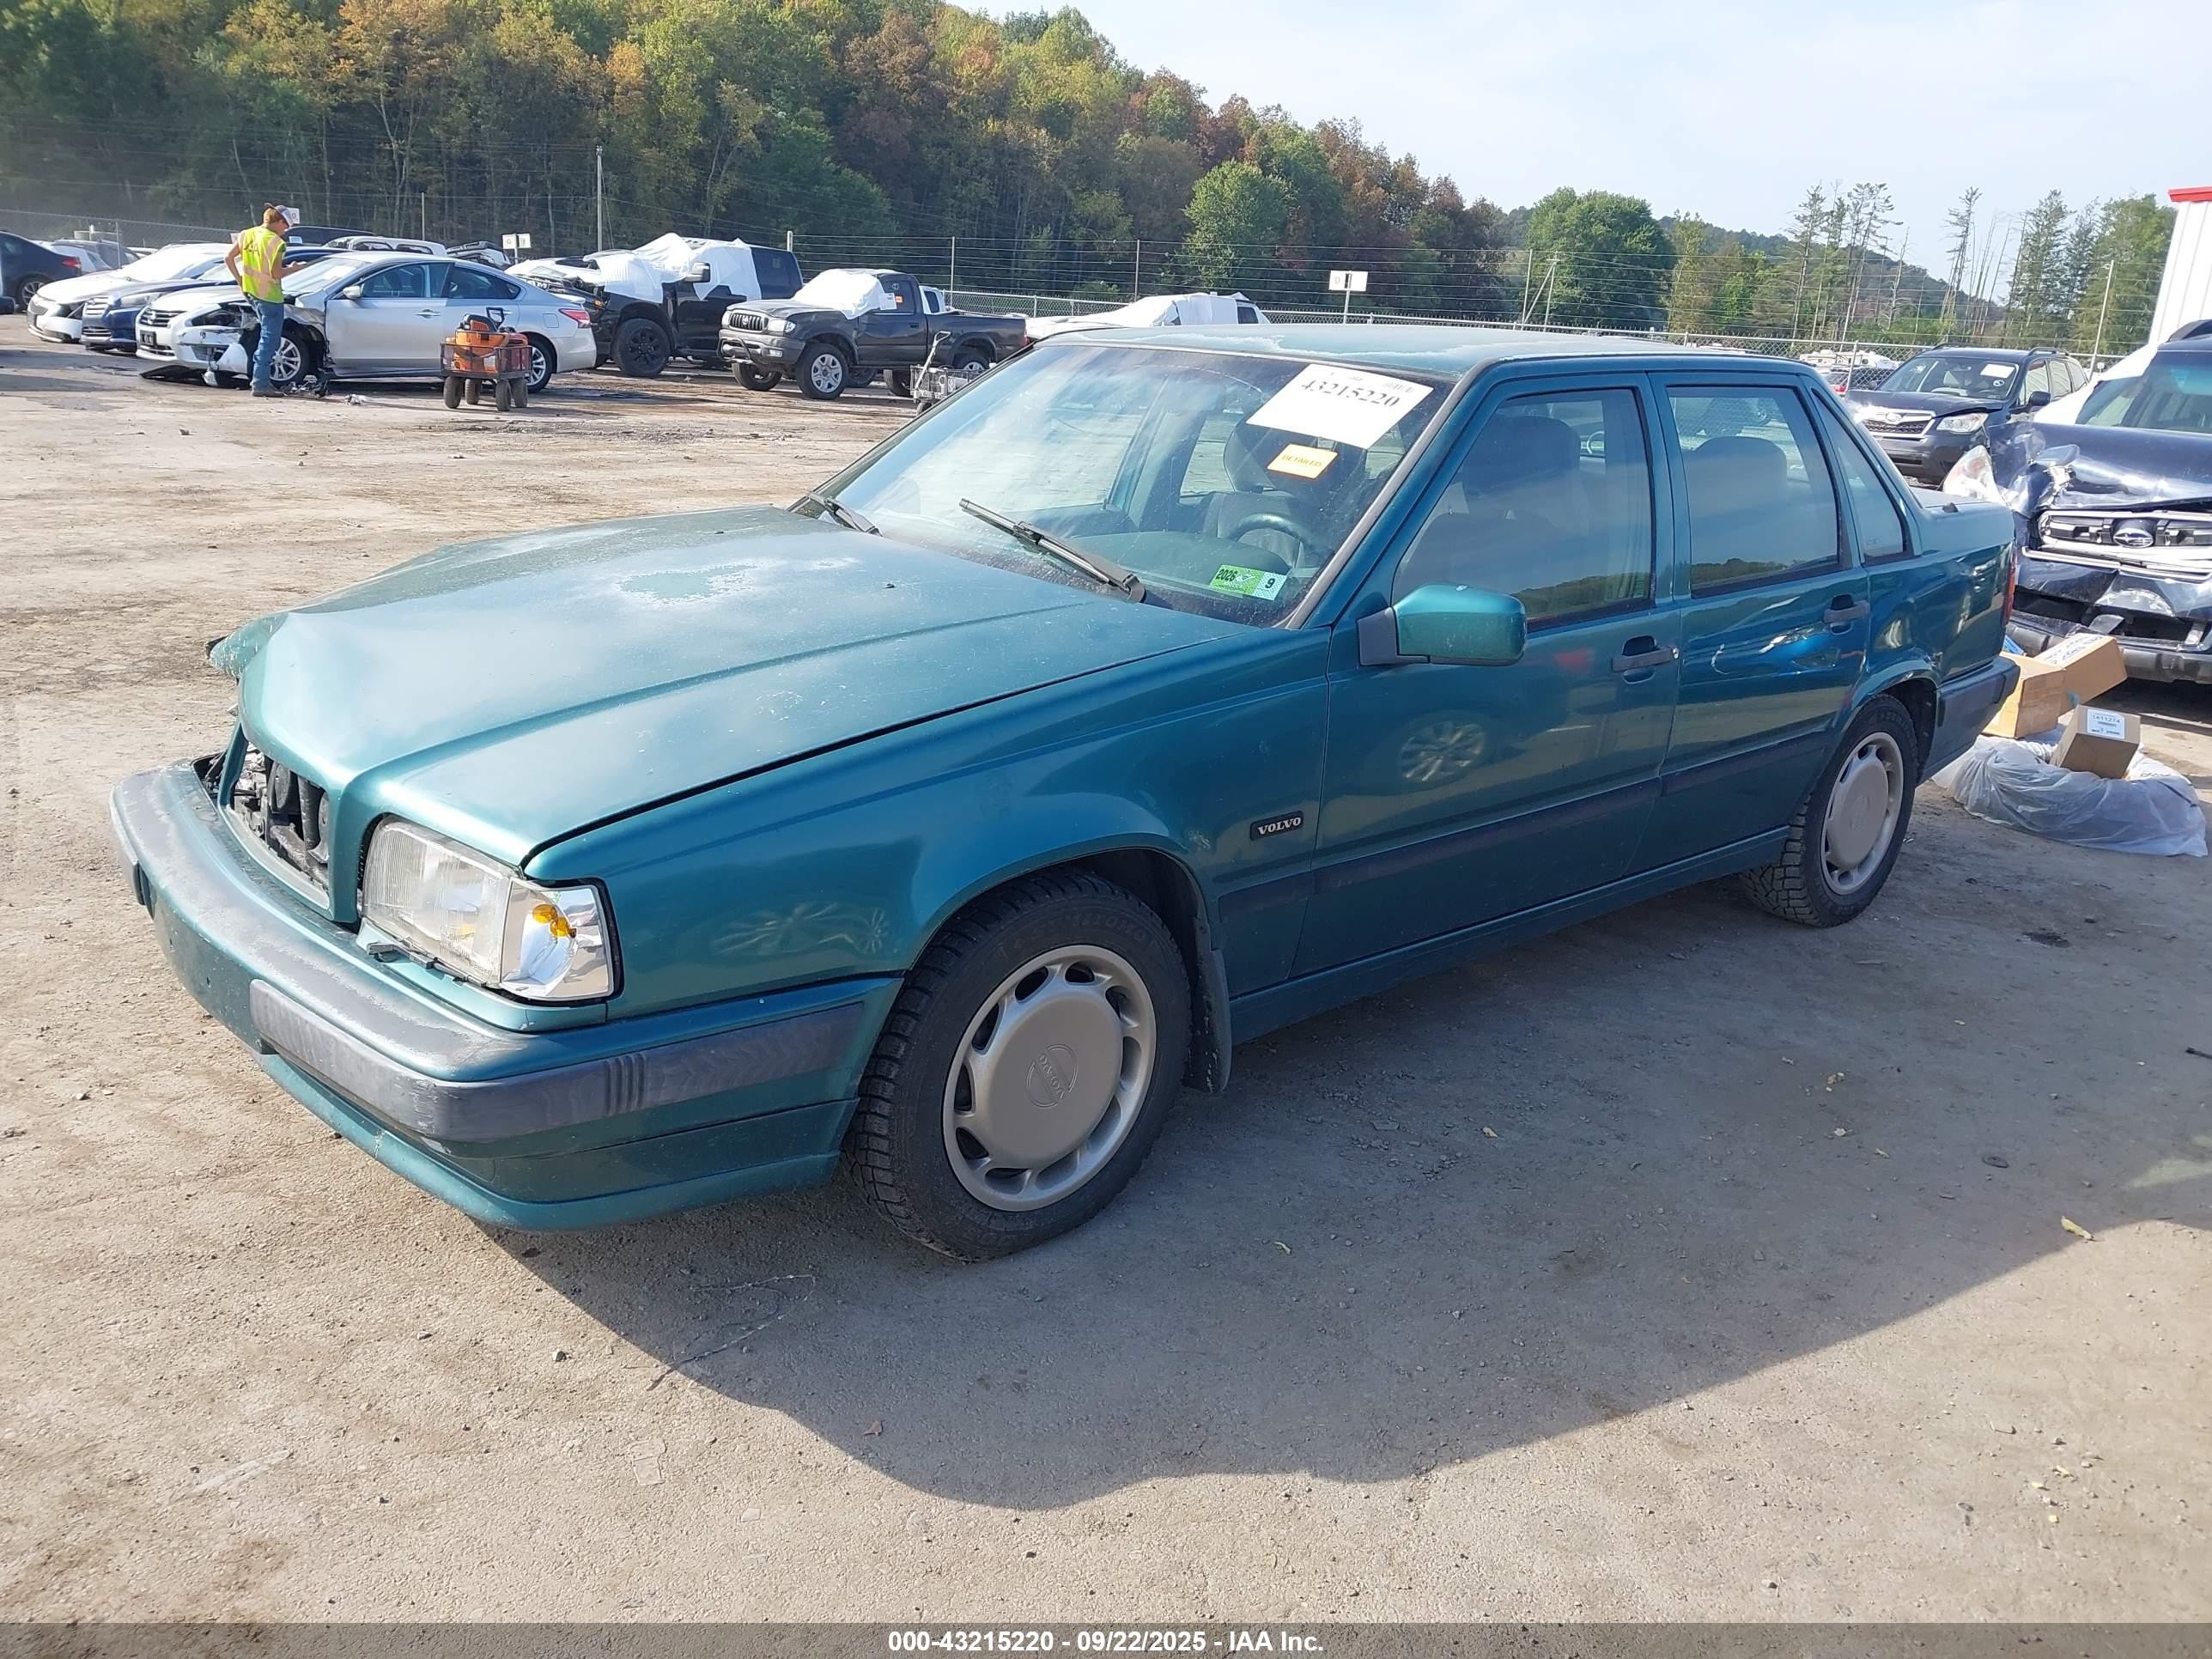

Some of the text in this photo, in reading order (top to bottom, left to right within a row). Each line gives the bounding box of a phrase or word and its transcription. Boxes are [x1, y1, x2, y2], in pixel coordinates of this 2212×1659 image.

[1302, 379, 1400, 407] 43215220
[1216, 568, 1276, 589] 2026 9
[1258, 817, 1301, 835] VOLVO
